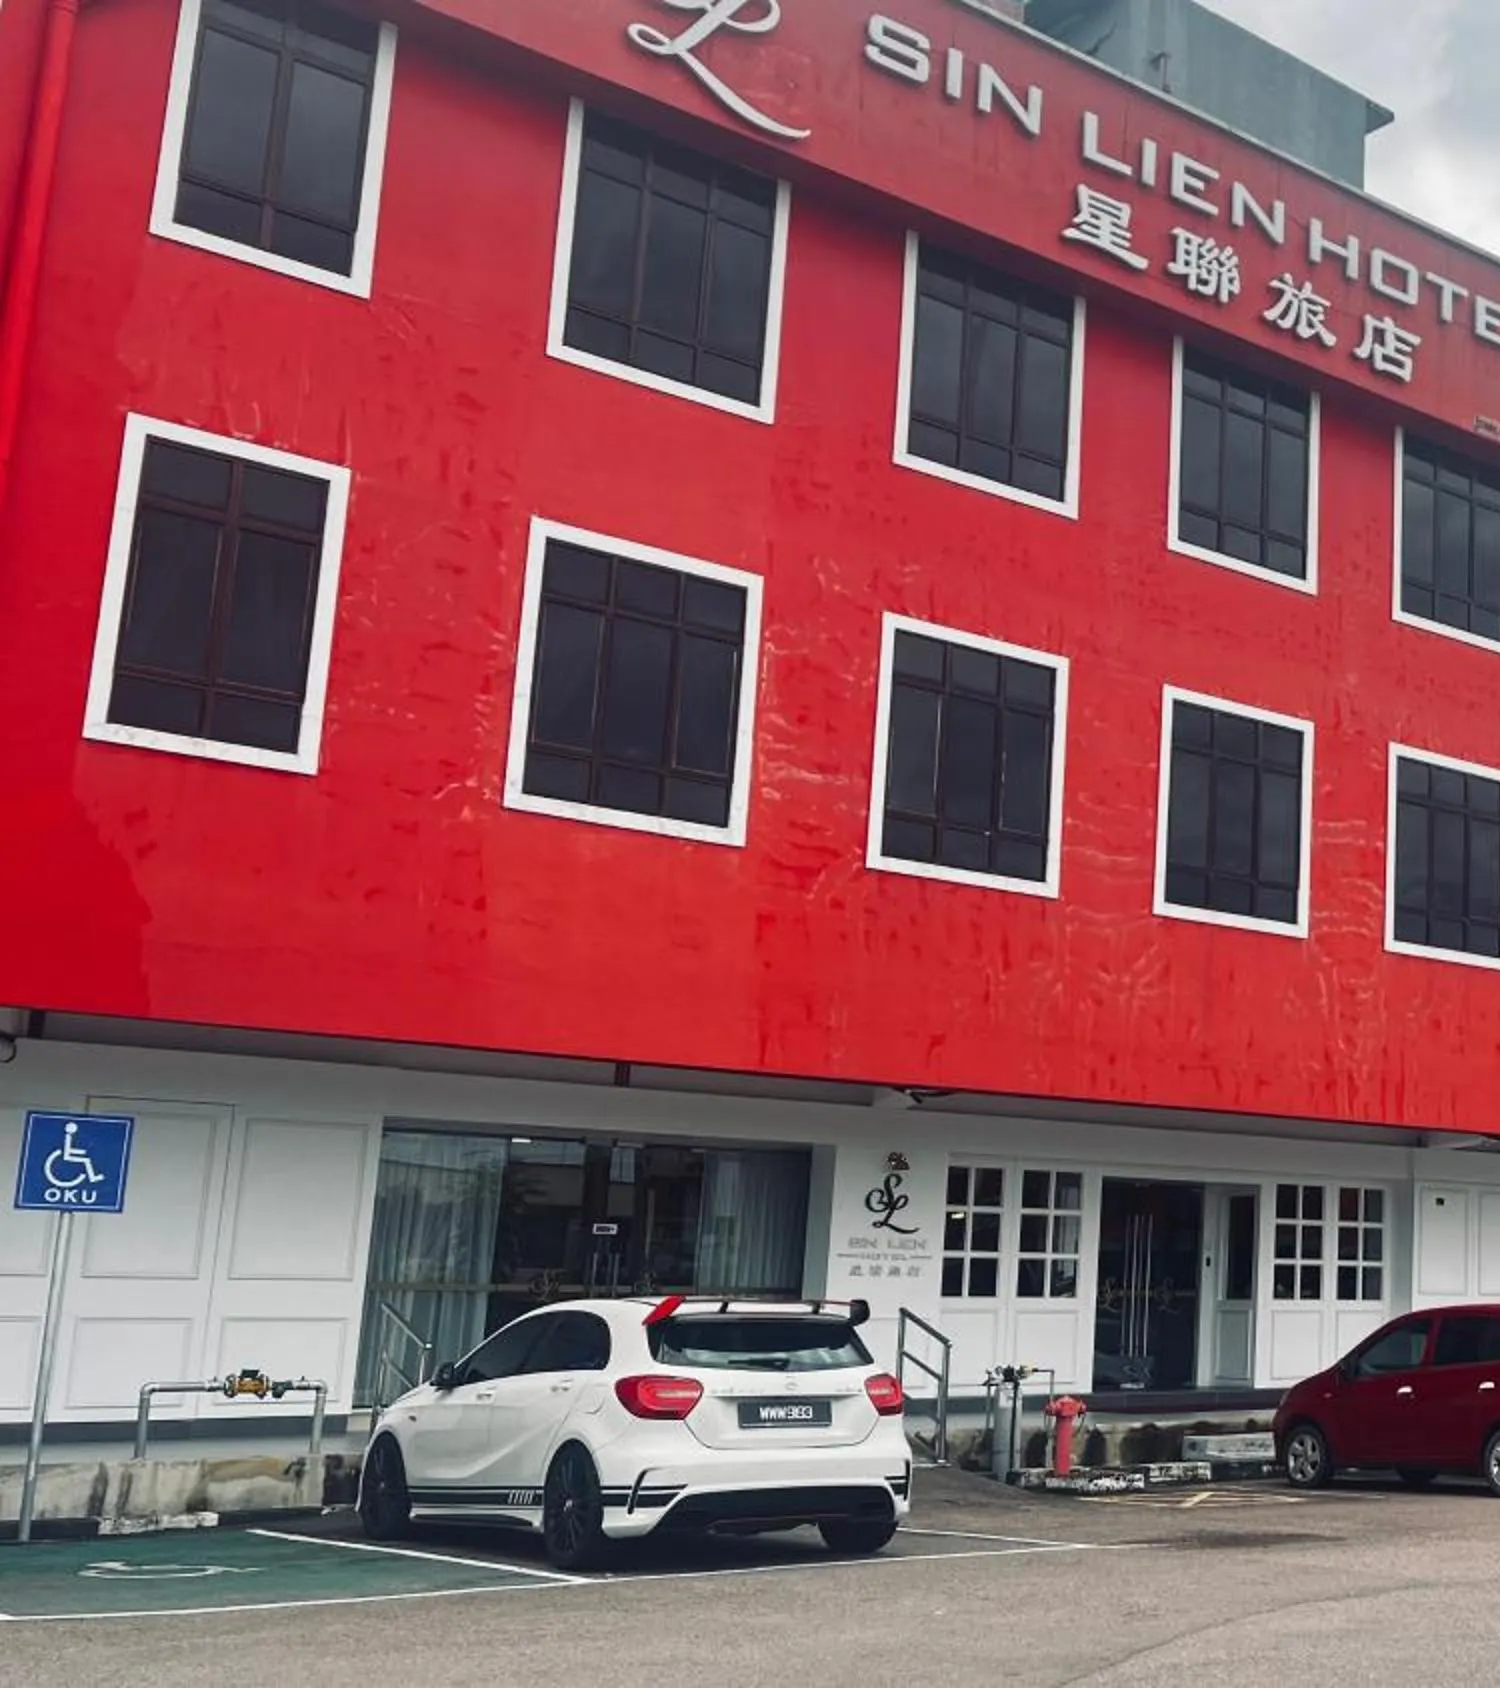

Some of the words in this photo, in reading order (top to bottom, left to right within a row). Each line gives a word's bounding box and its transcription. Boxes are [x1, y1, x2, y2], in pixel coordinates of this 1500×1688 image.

[864, 14, 1043, 135] SIN
[1083, 110, 1285, 245] LIEN
[1061, 183, 1421, 383] 星聯旅店
[44, 1188, 97, 1203] OKU
